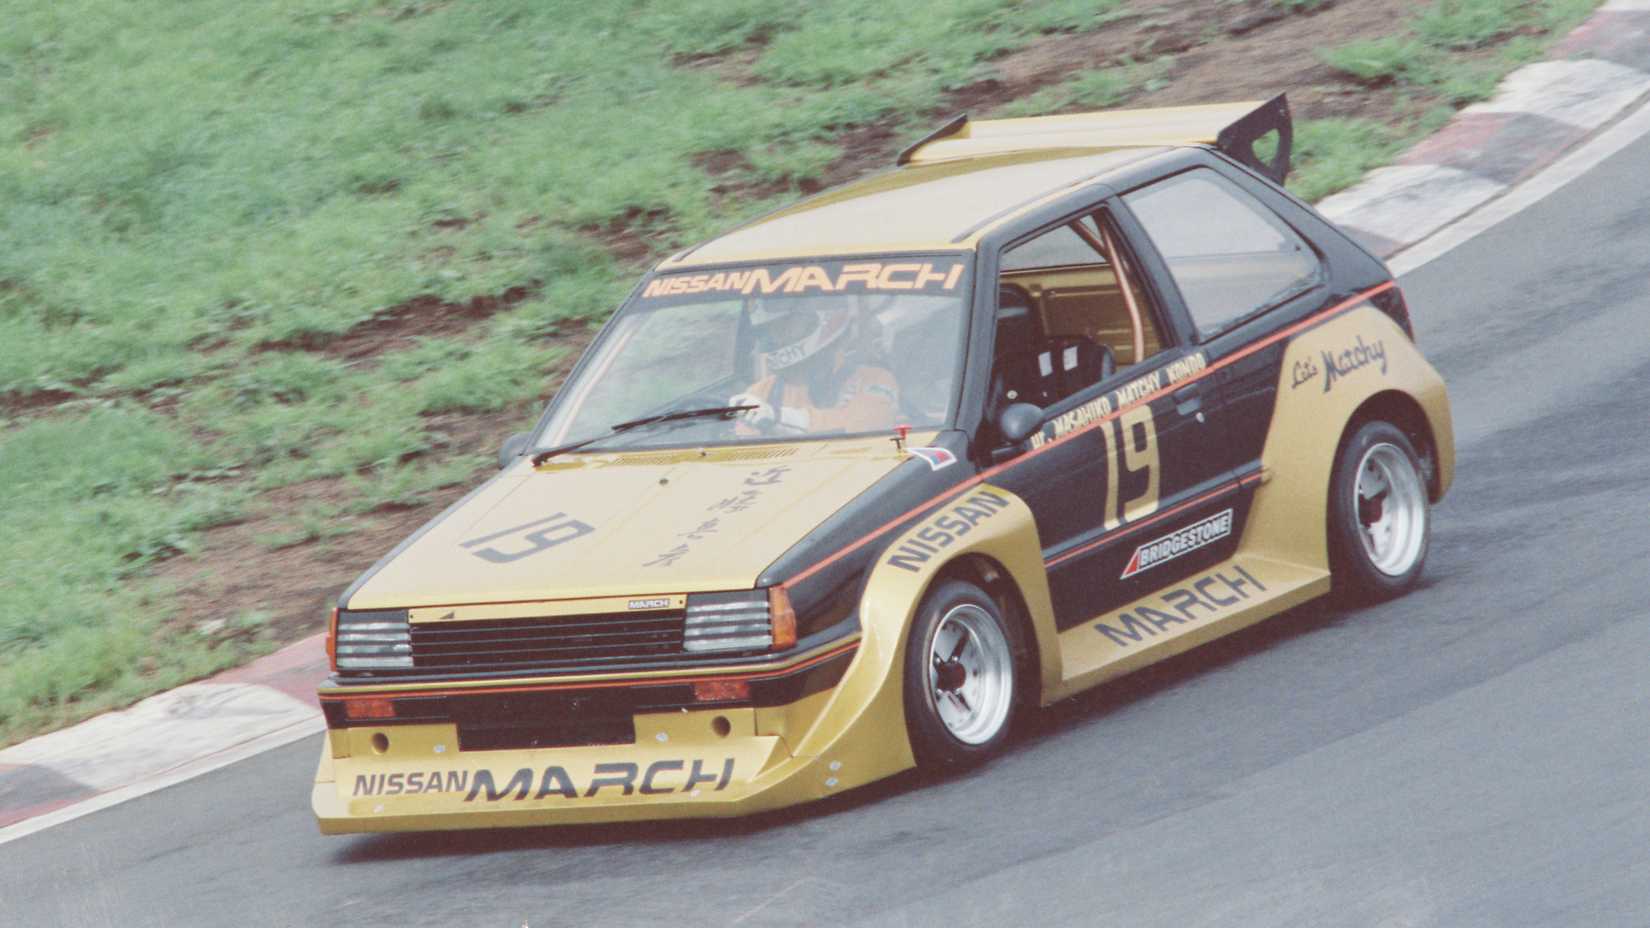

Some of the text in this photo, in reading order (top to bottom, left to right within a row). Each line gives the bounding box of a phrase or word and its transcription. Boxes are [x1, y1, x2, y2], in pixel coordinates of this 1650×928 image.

[642, 263, 965, 298] NISSAN MARCH
[1320, 335, 1387, 393] Matchy
[1099, 404, 1160, 531] 19
[458, 512, 595, 564] 19
[887, 491, 1009, 572] NISSAN
[1140, 515, 1228, 566] BRIDGESTONE
[629, 599, 670, 609] MARCH
[1094, 565, 1267, 647] MARCH
[353, 758, 735, 802] NISSAN MARCH
